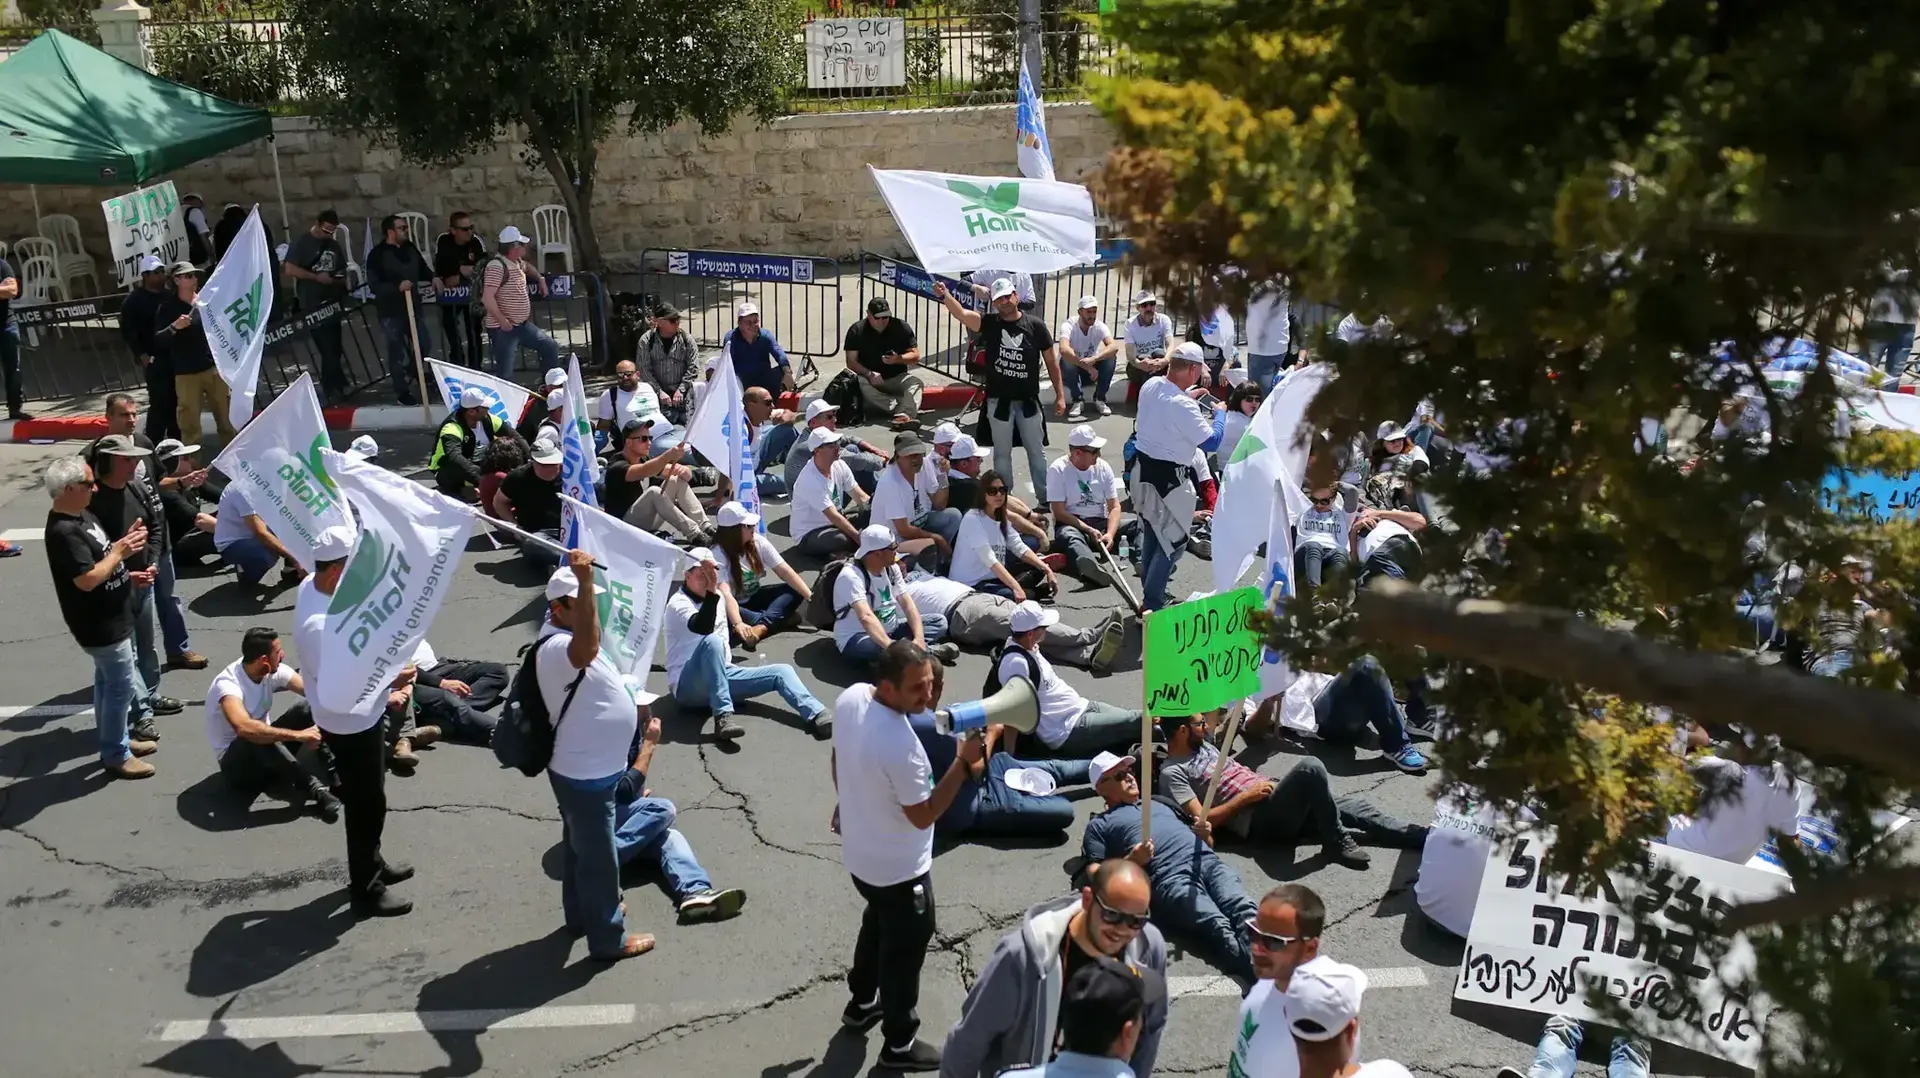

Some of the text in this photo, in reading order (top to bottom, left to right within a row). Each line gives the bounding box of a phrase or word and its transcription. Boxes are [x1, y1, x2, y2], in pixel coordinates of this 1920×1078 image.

[857, 19, 891, 38] ואם
[108, 182, 177, 227] עמונה
[125, 219, 171, 247] דורשת
[1010, 242, 1030, 252] the
[695, 258, 737, 274] הממשלה
[739, 262, 761, 276] ראש
[762, 264, 790, 277] משרד
[55, 303, 97, 319] משטרה
[304, 301, 342, 327] משטרה
[264, 324, 294, 346] OLICE
[999, 346, 1023, 362] Haifa
[1002, 368, 1029, 380] הפרנסה
[1174, 608, 1219, 655] תתנו
[1147, 677, 1190, 712] למות
[1469, 822, 1496, 839] חיפה
[1532, 903, 1711, 981] בתורה
[1707, 990, 1752, 1042] אל
